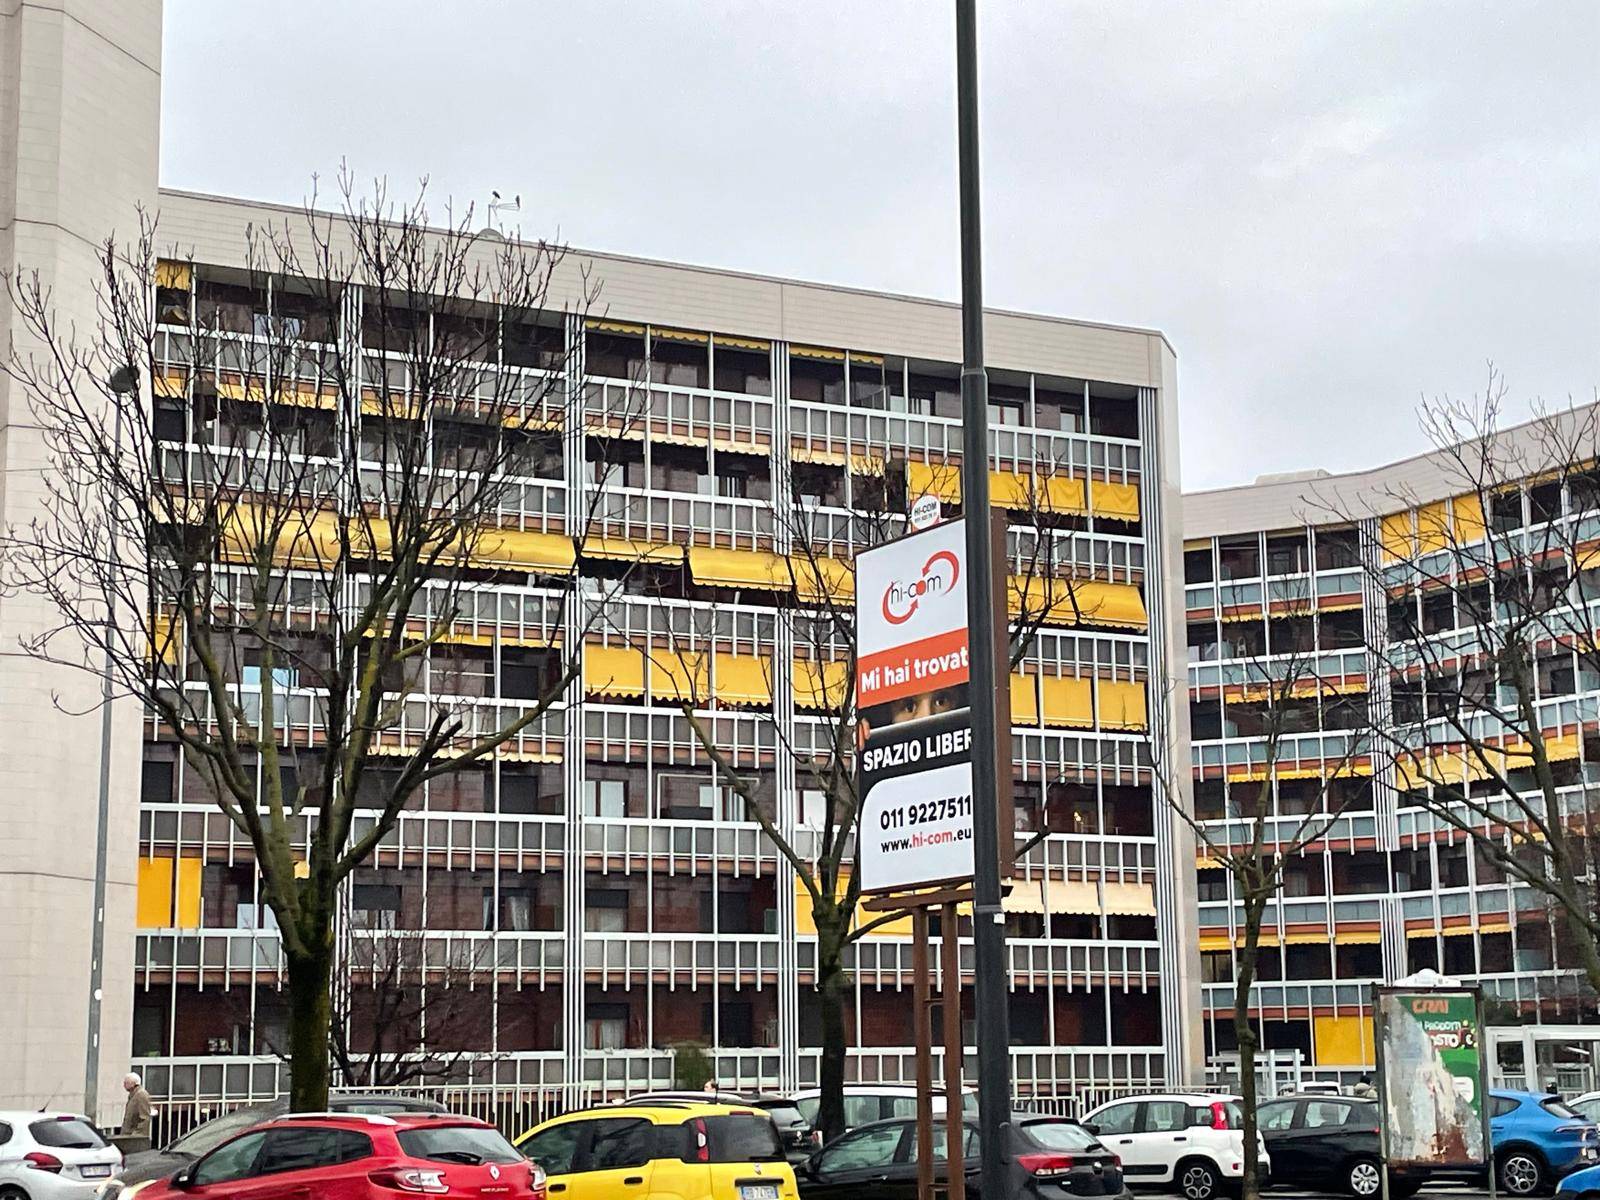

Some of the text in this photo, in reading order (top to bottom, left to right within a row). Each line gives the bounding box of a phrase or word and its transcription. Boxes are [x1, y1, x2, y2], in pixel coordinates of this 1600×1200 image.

[914, 502, 937, 517] HI-COM
[889, 575, 942, 604] hi-com
[861, 646, 969, 693] Mi hai trovat
[863, 740, 921, 771] SPAZIO
[880, 795, 971, 830] 011 9227511
[881, 828, 972, 853] www.hi-com.eu
